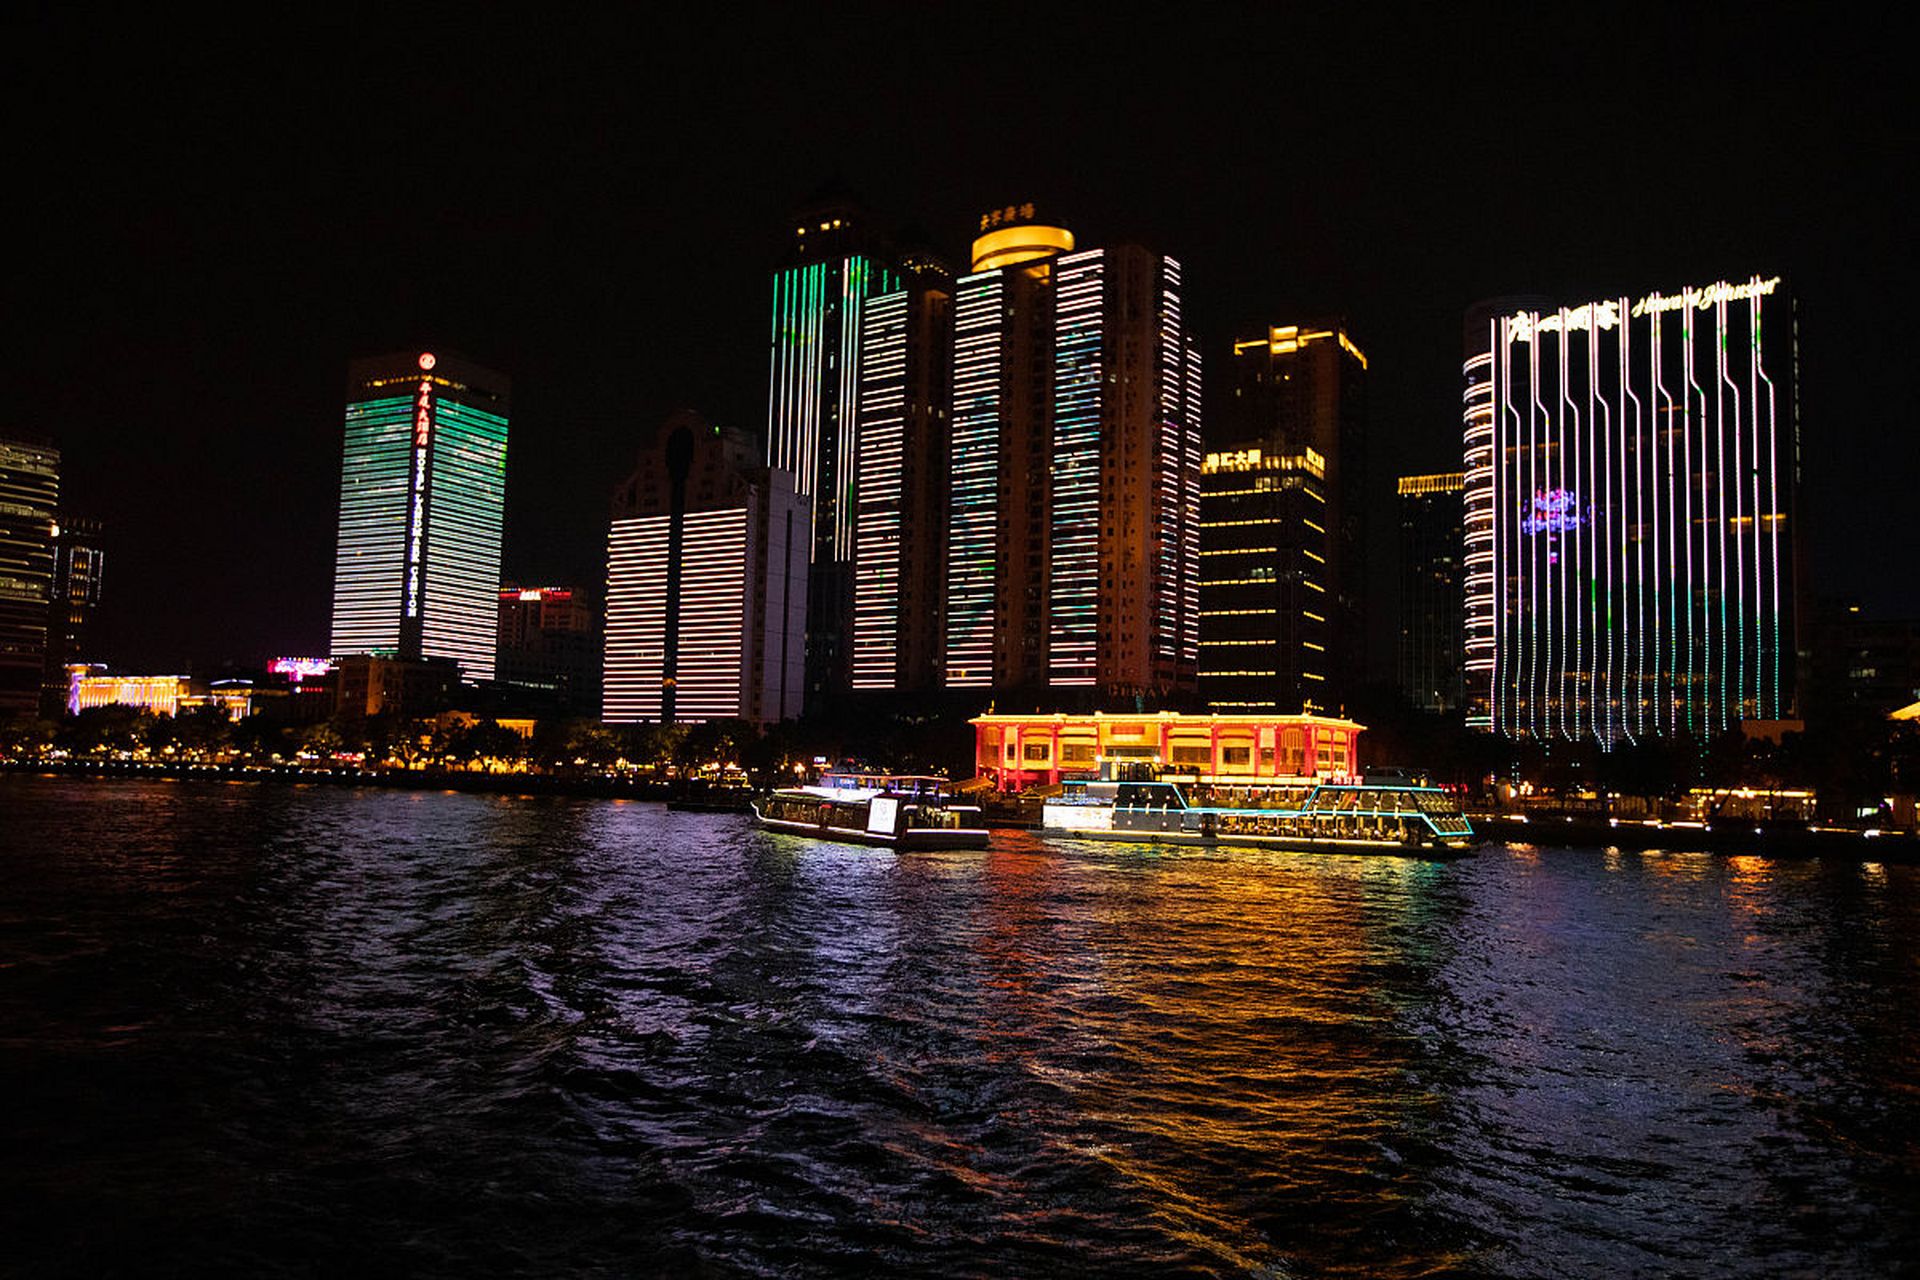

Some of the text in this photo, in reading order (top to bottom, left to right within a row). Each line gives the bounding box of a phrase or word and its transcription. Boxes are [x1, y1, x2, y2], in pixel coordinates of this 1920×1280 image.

[1632, 277, 1780, 317] Howard Johnson
[408, 449, 427, 617] HOTEL LANDMARK CANTON
